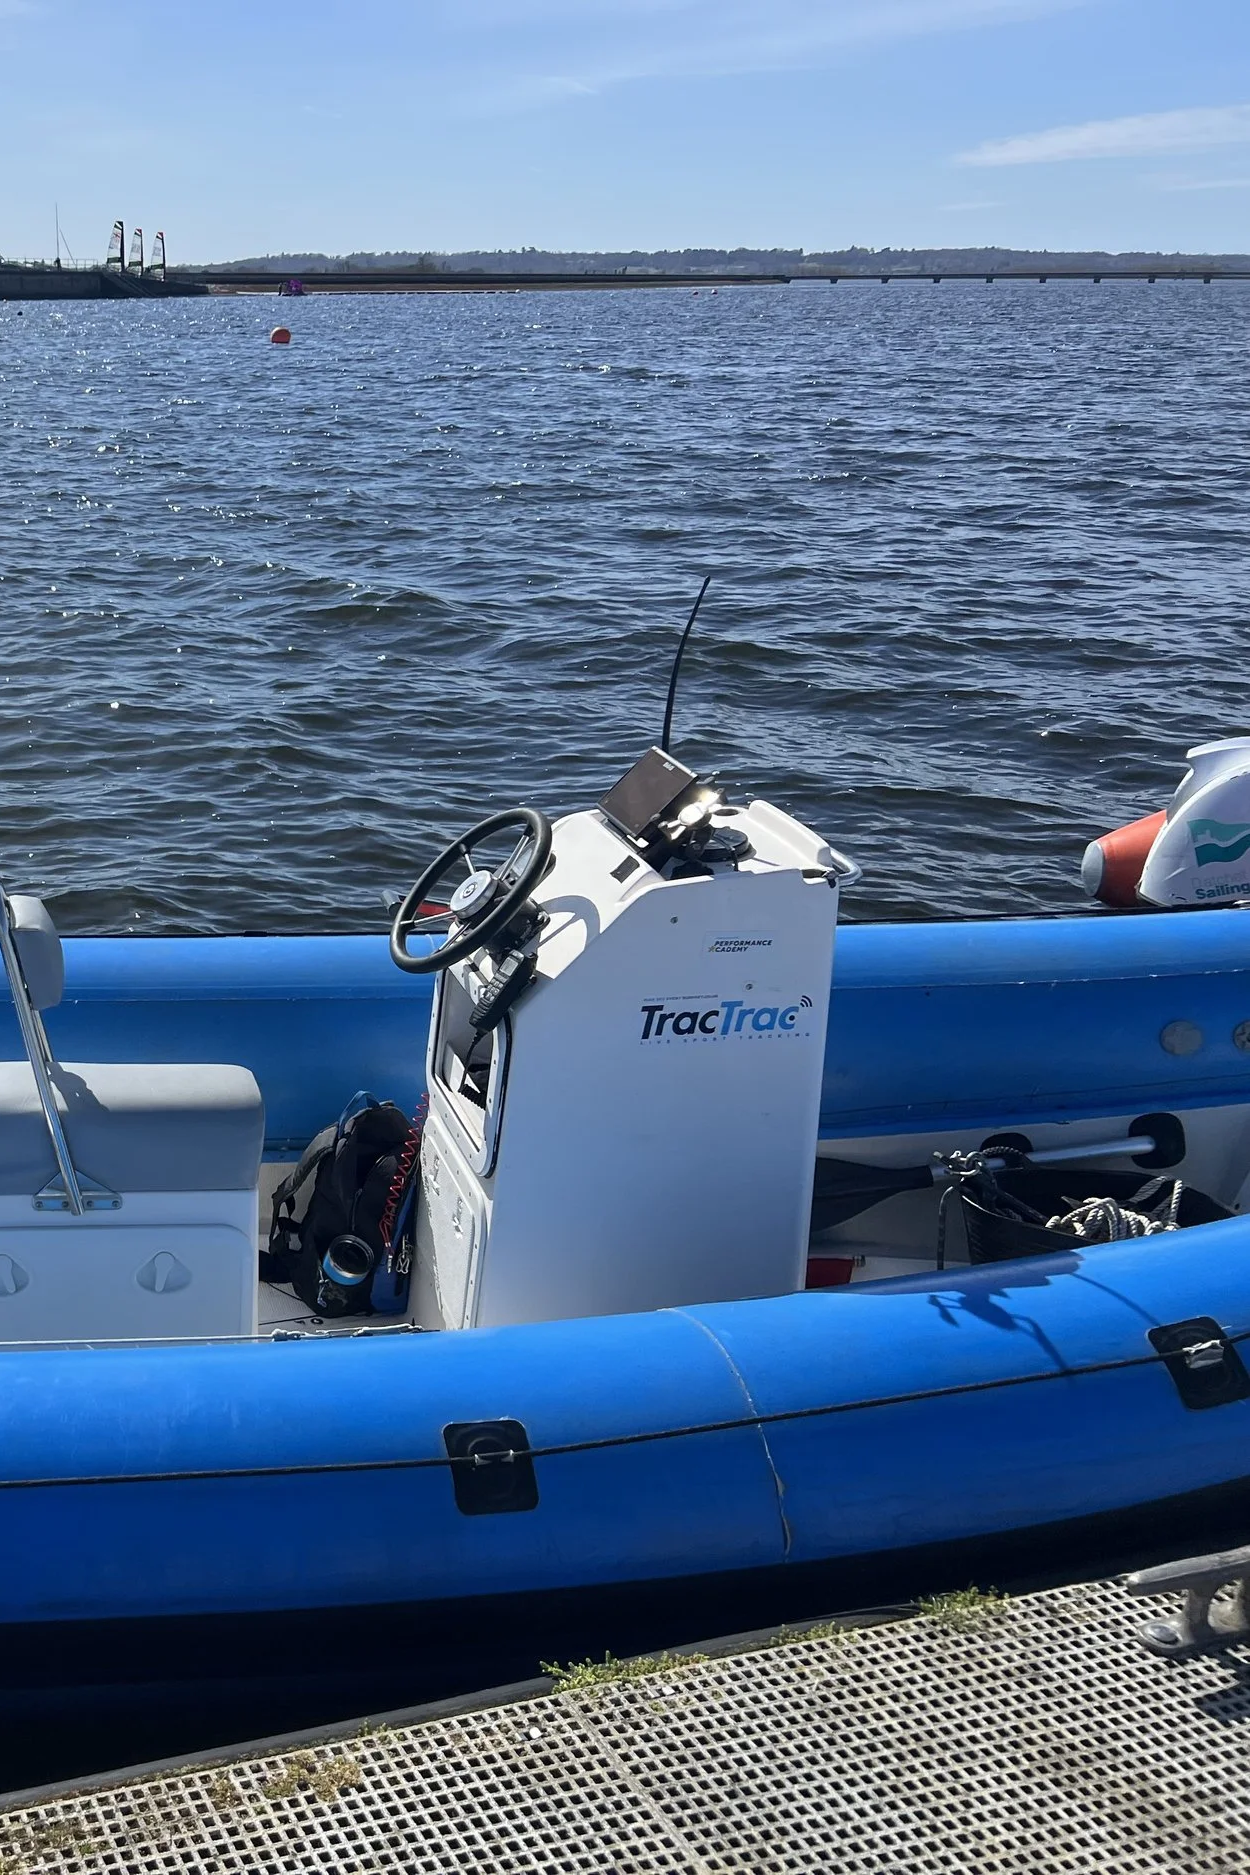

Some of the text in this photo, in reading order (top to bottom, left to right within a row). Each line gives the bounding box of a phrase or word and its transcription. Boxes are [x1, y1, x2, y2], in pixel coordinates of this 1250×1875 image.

[1195, 882, 1250, 899] Sailing
[640, 1000, 800, 1041] TracTrac
[683, 1036, 727, 1044] SPORT
[739, 1032, 811, 1040] TRACKING
